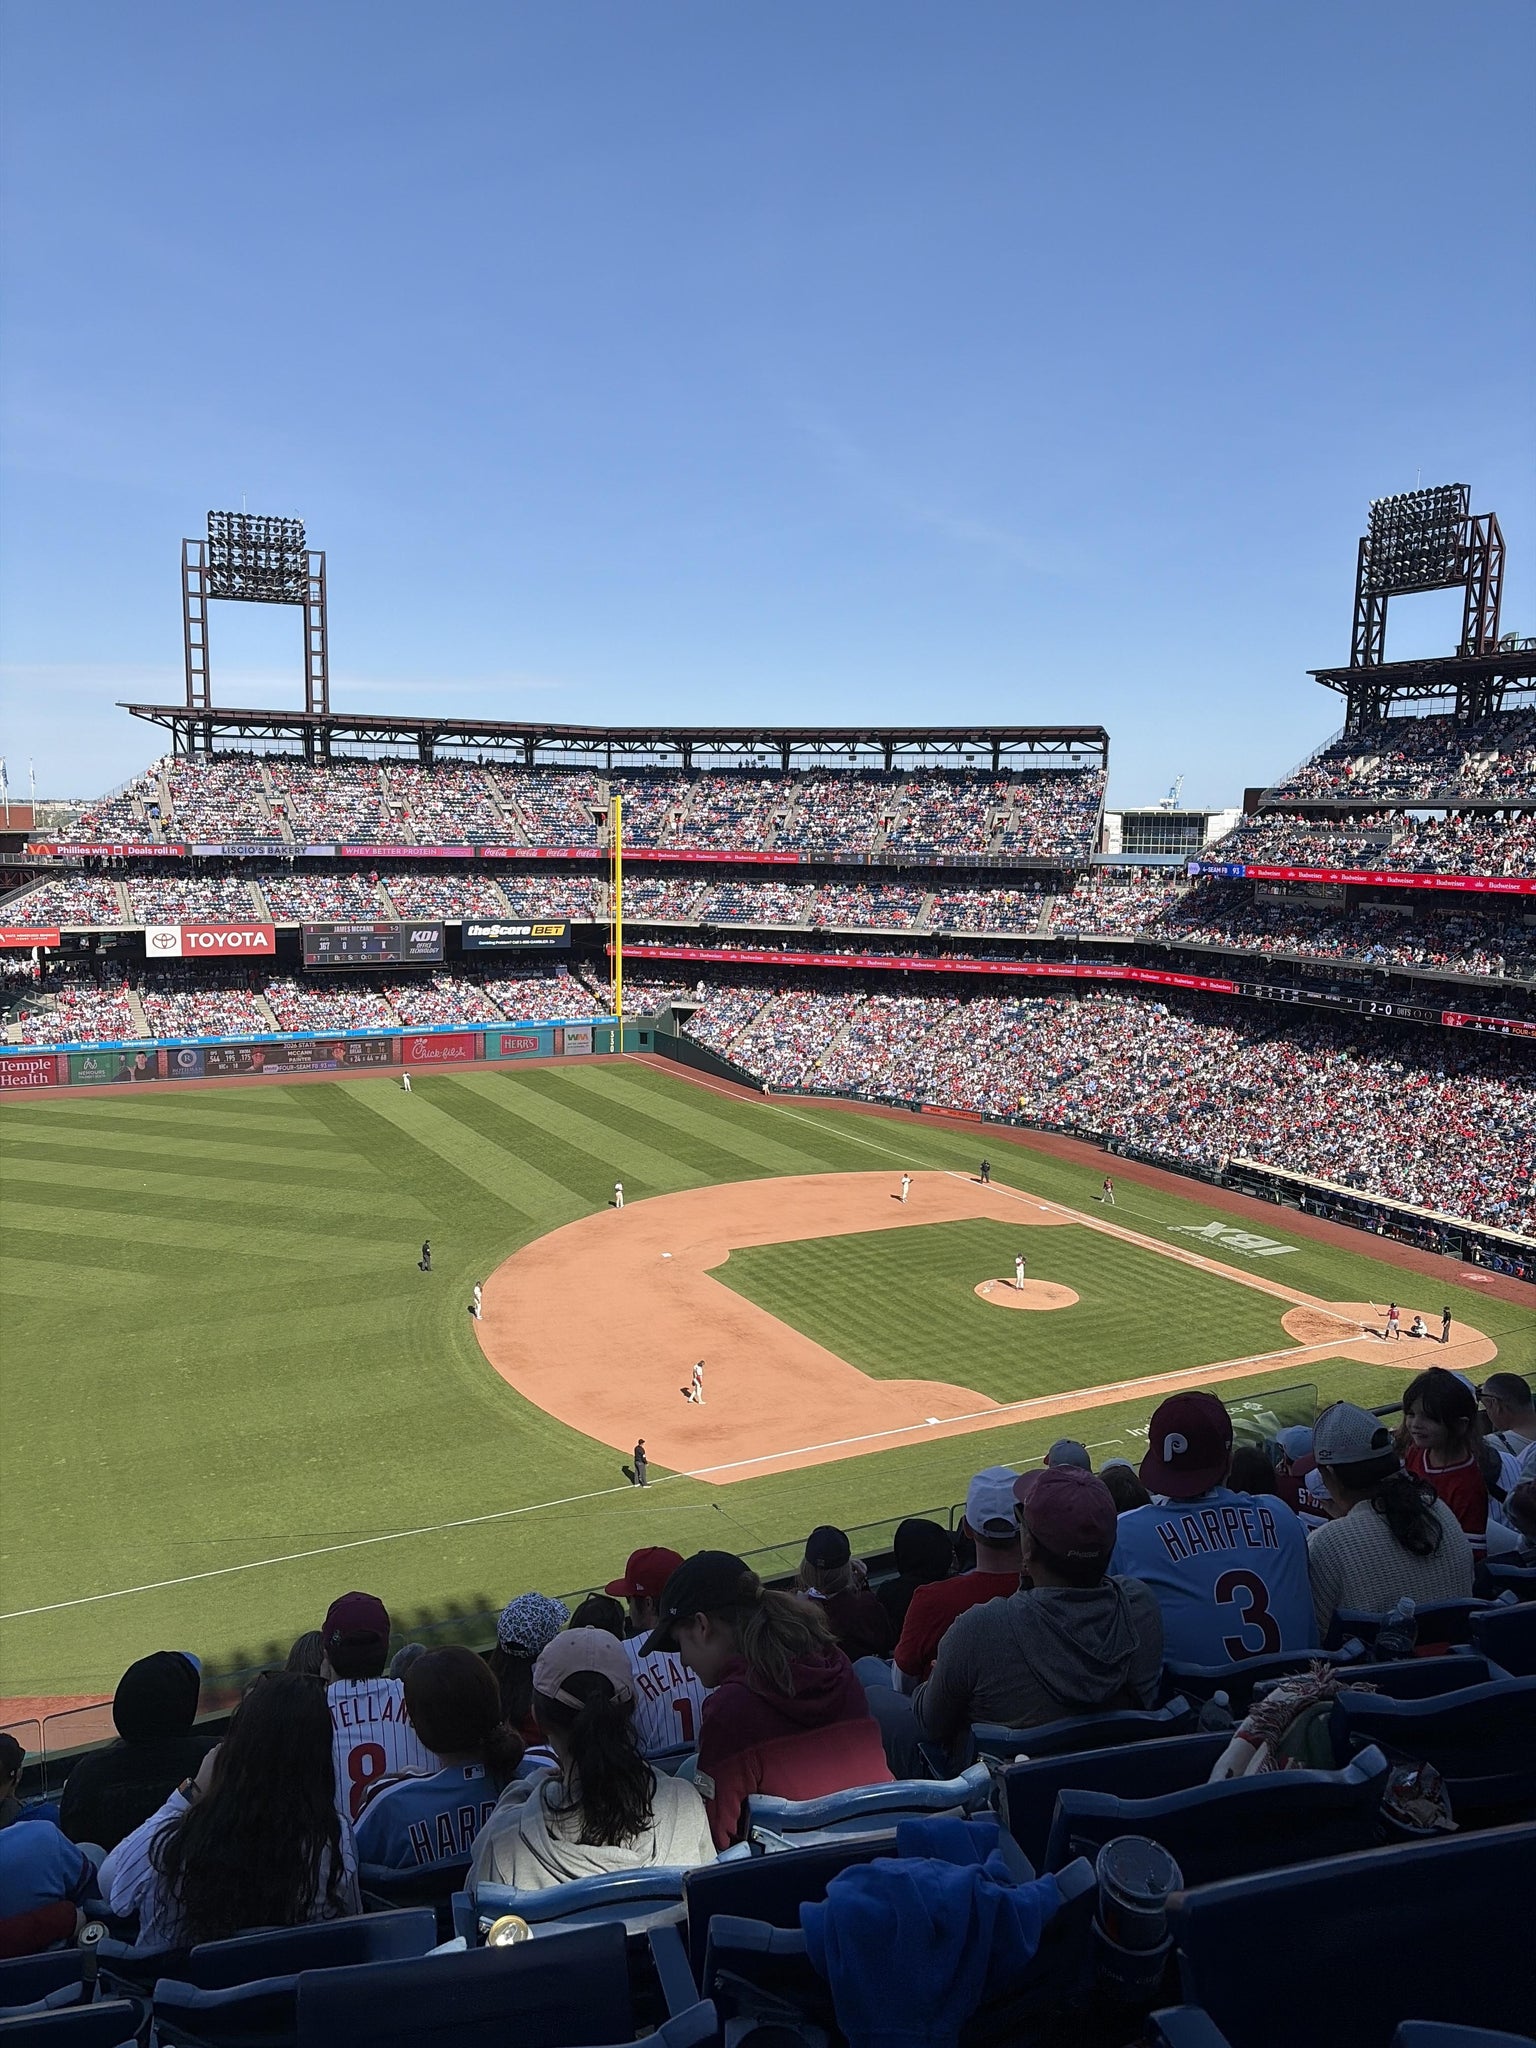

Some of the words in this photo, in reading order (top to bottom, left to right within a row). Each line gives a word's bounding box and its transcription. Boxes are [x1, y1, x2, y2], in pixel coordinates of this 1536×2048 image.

[57, 846, 90, 854] Phillies
[128, 846, 153, 854] Deals
[154, 846, 168, 854] roll
[169, 846, 178, 854] in
[222, 846, 264, 854] LISCIO'S
[268, 846, 307, 854] BAKERY
[1342, 874, 1368, 882] Budweiser
[1387, 876, 1415, 884] Budweiser
[1436, 879, 1466, 887] Budweiser
[1489, 882, 1521, 890] Budweiser
[467, 924, 531, 937] theScore
[534, 926, 563, 935] BET
[186, 932, 268, 948] TOYOTA
[410, 930, 439, 942] KDI
[342, 942, 347, 950] 0
[362, 941, 367, 949] 3
[1140, 972, 1160, 980] Budweiser
[1173, 977, 1195, 985] Budweiser
[1210, 982, 1231, 990] Budweiser
[1396, 1005, 1411, 1017] OUTS
[504, 1038, 535, 1049] HERR'S
[18, 1044, 50, 1052] Independence
[0, 1058, 51, 1074] Temple
[279, 1063, 311, 1071] FOUR-SEAM
[0, 1073, 49, 1086] Health
[1163, 1432, 1188, 1463] P
[1155, 1506, 1280, 1563] HARPER
[1213, 1568, 1282, 1662] 3
[636, 1658, 697, 1702] REAL
[672, 1697, 694, 1742] 1
[347, 1742, 387, 1820] 8
